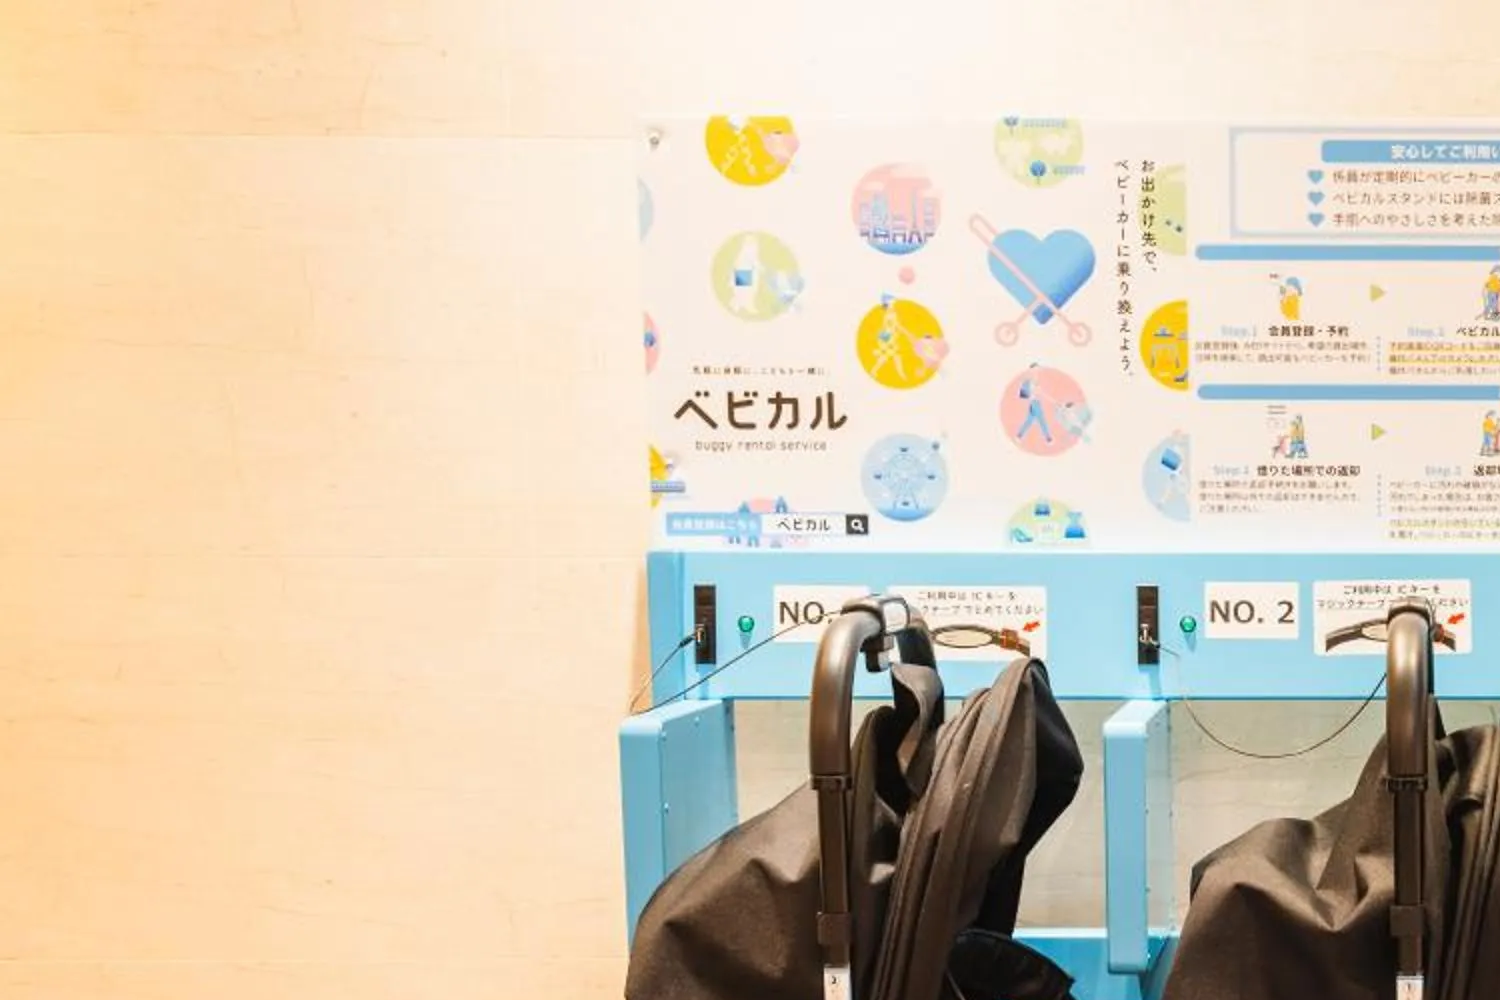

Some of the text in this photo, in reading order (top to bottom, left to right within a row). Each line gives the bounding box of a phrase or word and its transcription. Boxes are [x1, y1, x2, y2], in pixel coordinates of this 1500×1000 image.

[1141, 159, 1157, 272] お出かけ先で、
[1114, 159, 1134, 376] ベビーカーに乗り換えよう。
[673, 390, 848, 431] ベビカル
[695, 440, 827, 452] buggy rental service
[1256, 464, 1361, 477] 借りた場所での返却
[776, 517, 831, 532] ベビカル
[1209, 599, 1295, 624] NO. 2
